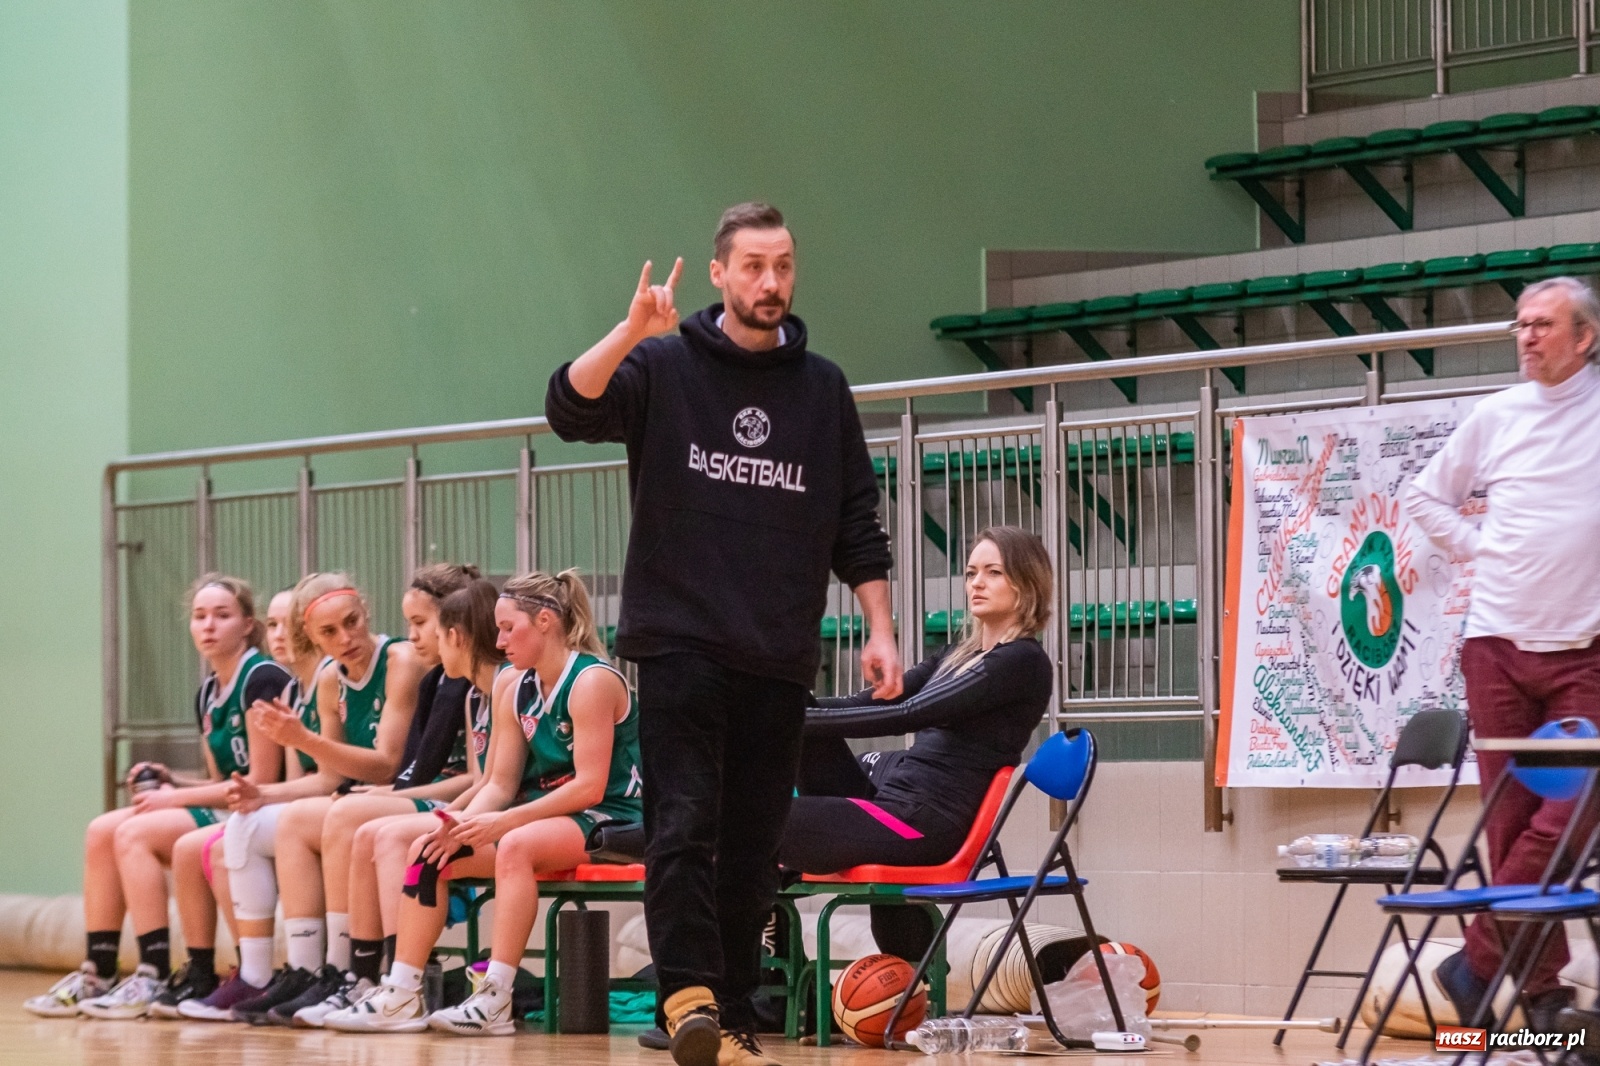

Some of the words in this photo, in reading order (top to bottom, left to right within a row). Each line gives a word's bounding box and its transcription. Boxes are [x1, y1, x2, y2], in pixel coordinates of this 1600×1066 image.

[688, 442, 806, 492] BASKETBALL
[1326, 497, 1368, 599] GRAMY
[1369, 491, 1399, 537] DLA
[1396, 521, 1420, 596] WAS
[231, 736, 249, 767] 8
[877, 969, 898, 985] FIBA
